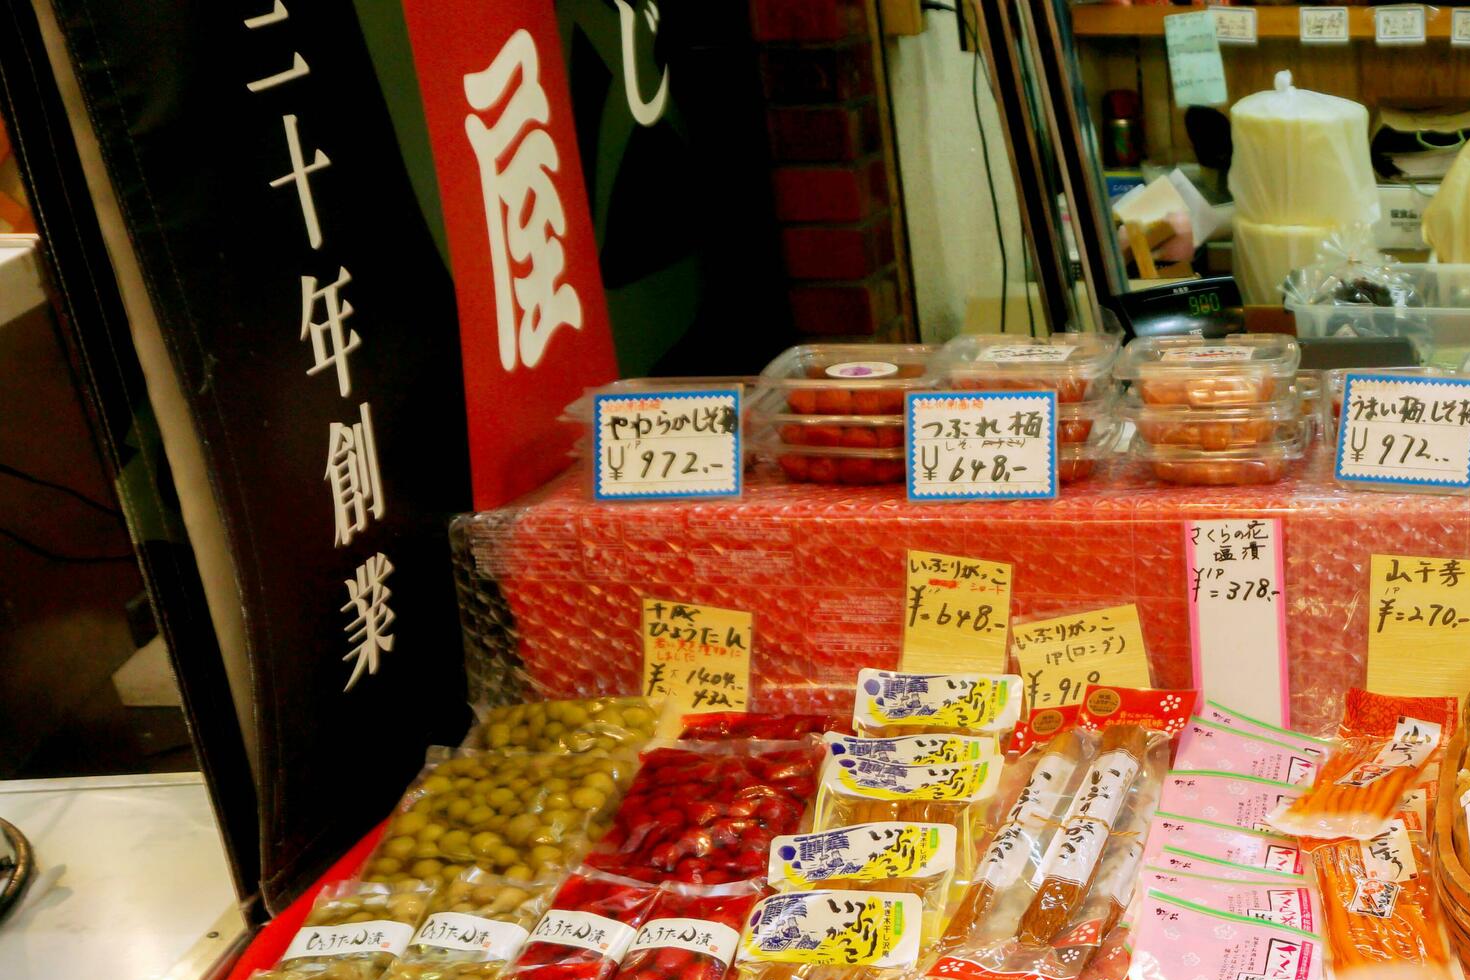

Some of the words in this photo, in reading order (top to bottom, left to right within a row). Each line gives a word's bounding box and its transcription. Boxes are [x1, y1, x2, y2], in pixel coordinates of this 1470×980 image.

[464, 29, 582, 371] 屋
[1190, 520, 1269, 545] さくらの花
[305, 928, 386, 953] ひょうたん漬
[418, 922, 490, 948] ひょうたん漬
[534, 918, 606, 947] ひょうたん漬
[635, 925, 714, 954] ひょうたん漬
